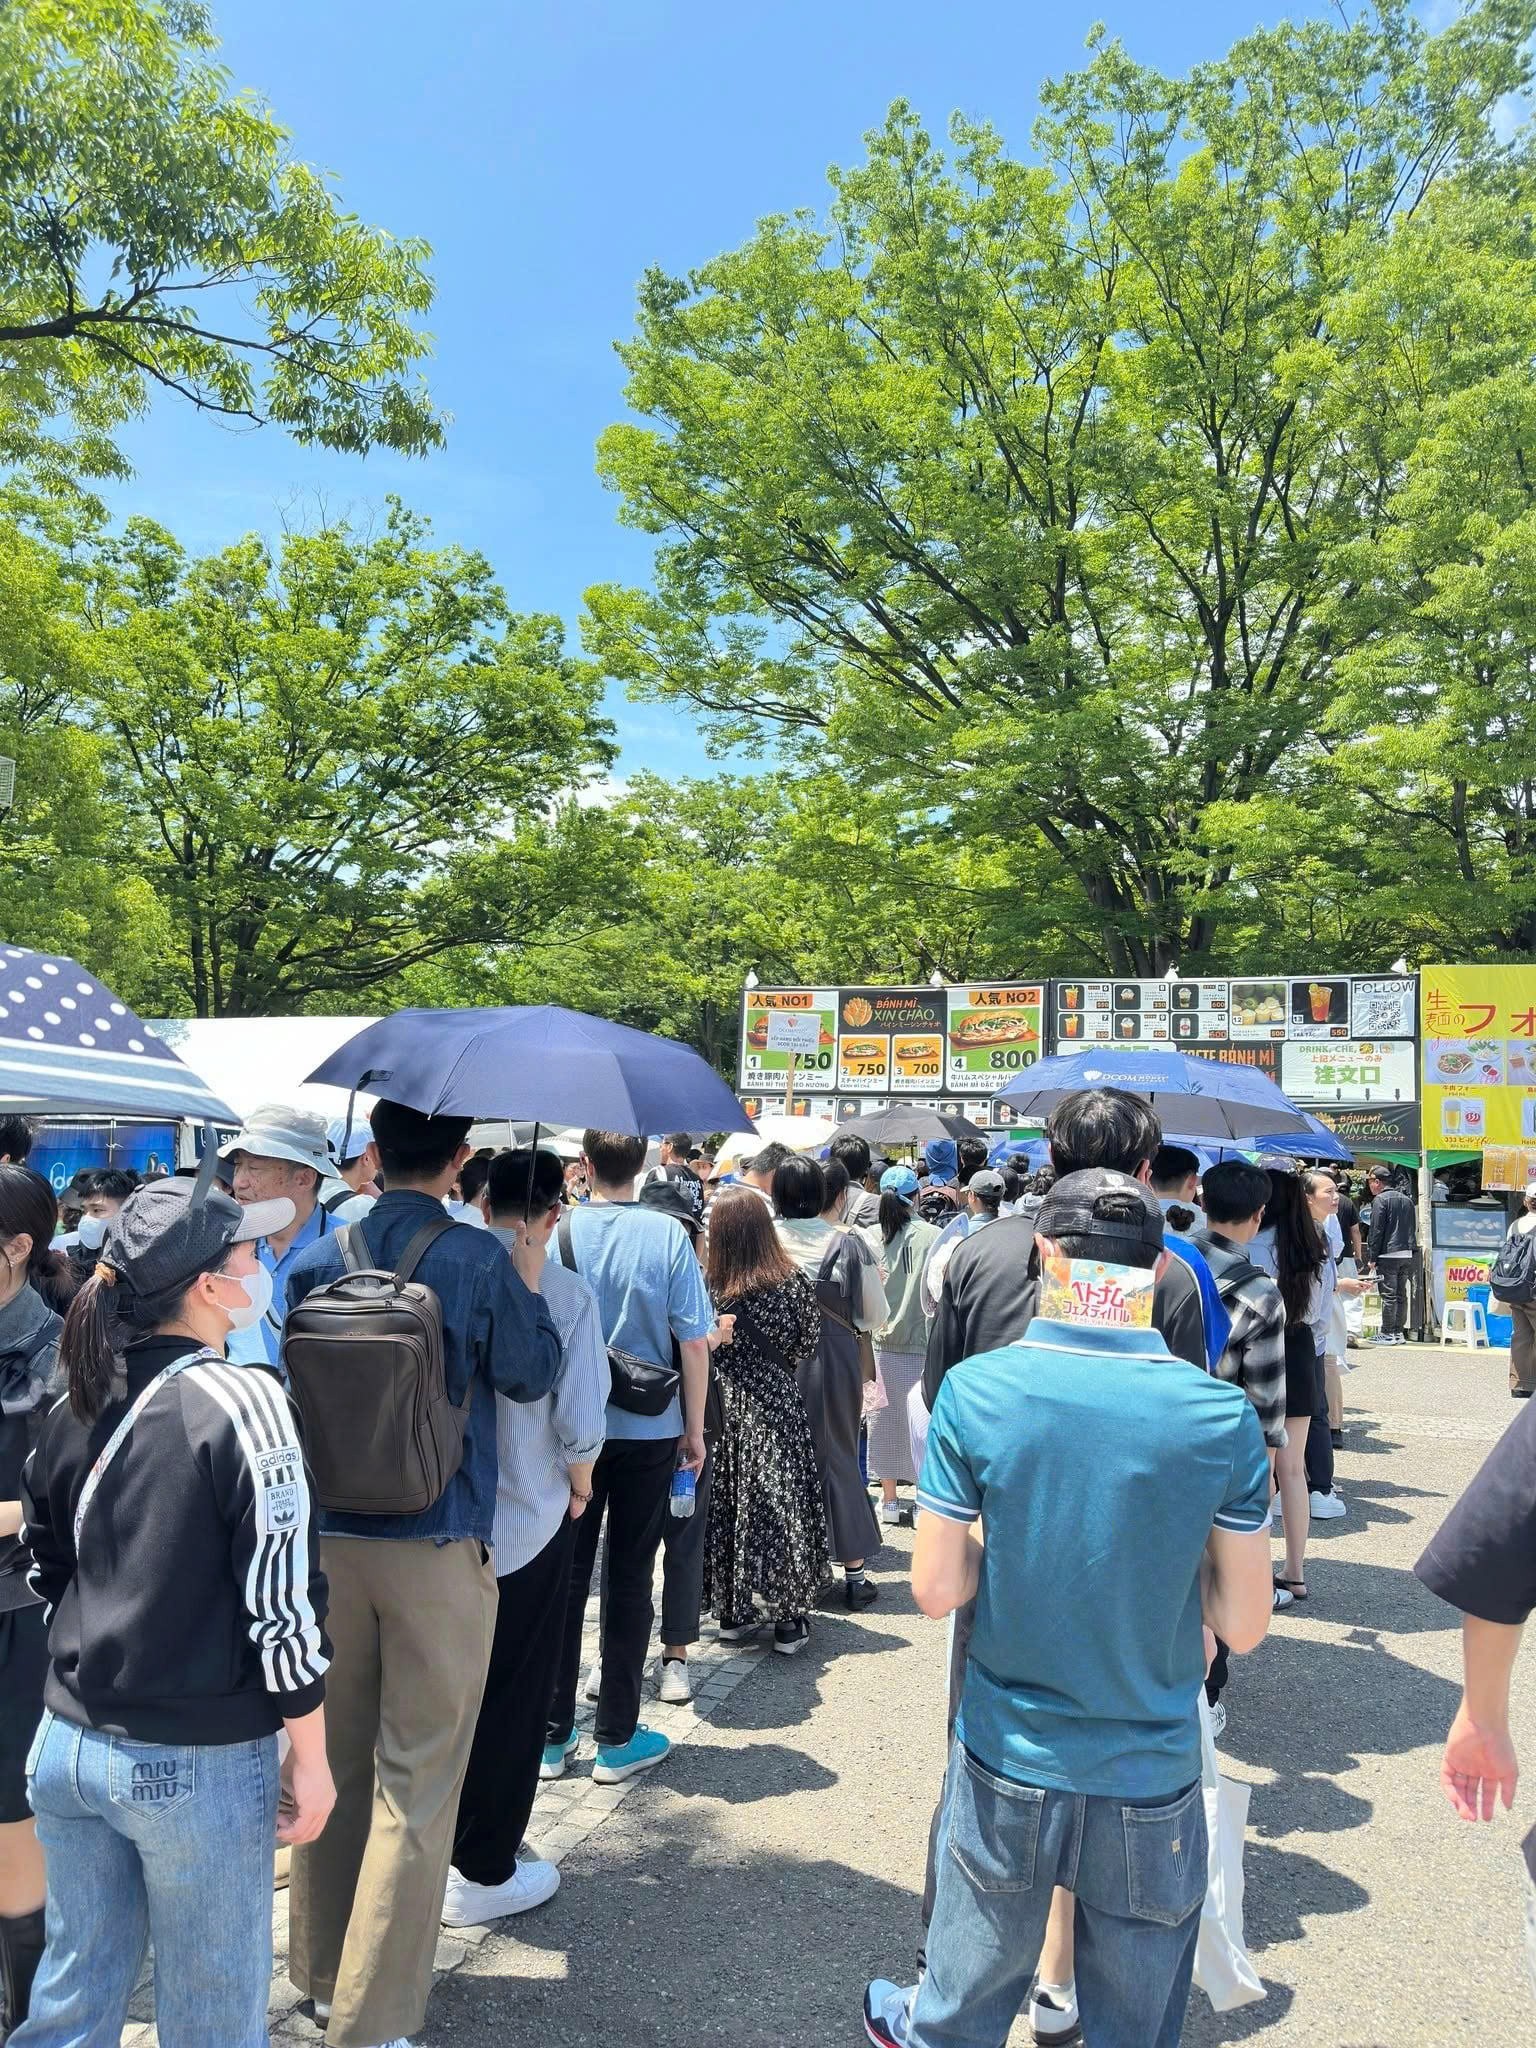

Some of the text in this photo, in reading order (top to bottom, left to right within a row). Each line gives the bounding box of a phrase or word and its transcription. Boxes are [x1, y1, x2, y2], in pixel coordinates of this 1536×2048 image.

[1354, 981, 1415, 993] FOLLOW
[752, 995, 808, 1007] 人気 NO1
[876, 997, 918, 1008] BÁNH MÌ
[975, 992, 1036, 1005] 人気 NO2
[1426, 988, 1451, 1010] 生
[873, 1005, 935, 1021] XIN CHÀO
[1425, 1011, 1465, 1035] 麺の
[750, 1056, 757, 1067] 1
[955, 1058, 963, 1069] 4
[990, 1050, 1036, 1069] 800
[1311, 1055, 1382, 1063] 上記メニューのみ
[857, 1063, 885, 1075] 750
[913, 1063, 939, 1074] 700
[1314, 1065, 1381, 1085] 注文口
[1102, 1073, 1137, 1081] DCOM
[1340, 1113, 1367, 1123] BÁNH
[1337, 1121, 1399, 1135] XIN CHÀO
[1448, 1264, 1485, 1282] NƯỚC
[1072, 1281, 1125, 1308] ベトナム
[1063, 1300, 1130, 1322] フェスティバル
[260, 1451, 297, 1468] adidas
[132, 1760, 176, 1779] miu
[132, 1782, 177, 1801] miu
